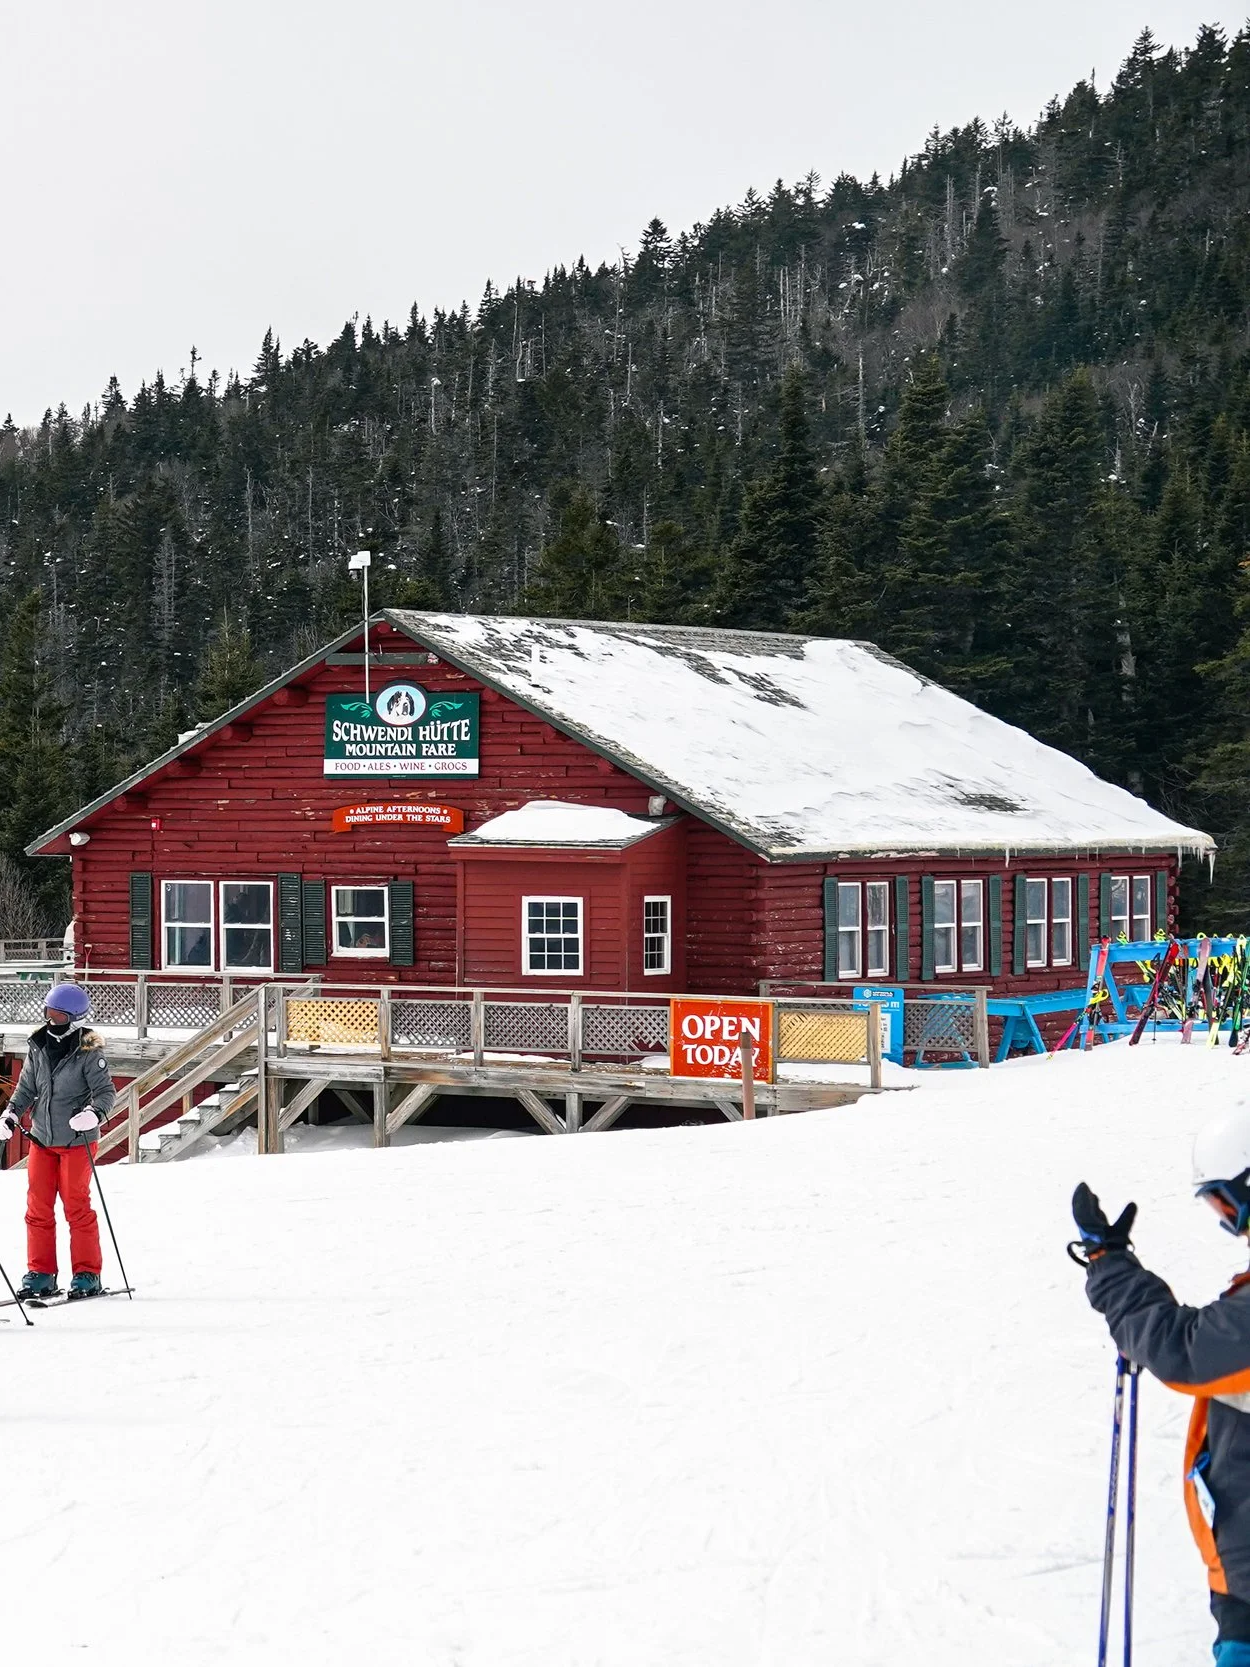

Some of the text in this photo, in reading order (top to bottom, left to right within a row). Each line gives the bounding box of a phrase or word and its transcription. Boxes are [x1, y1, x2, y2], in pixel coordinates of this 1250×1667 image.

[333, 719, 470, 741] SCHWENDI HÜTTE
[345, 743, 456, 756] MOUNTAIN FARE
[334, 761, 468, 771] FOOD ALES WINE GROGS
[356, 806, 440, 815] ALPINE AFTERNOONS
[345, 813, 451, 824] DINING UNDER THE STARS
[682, 1015, 760, 1041] OPEN
